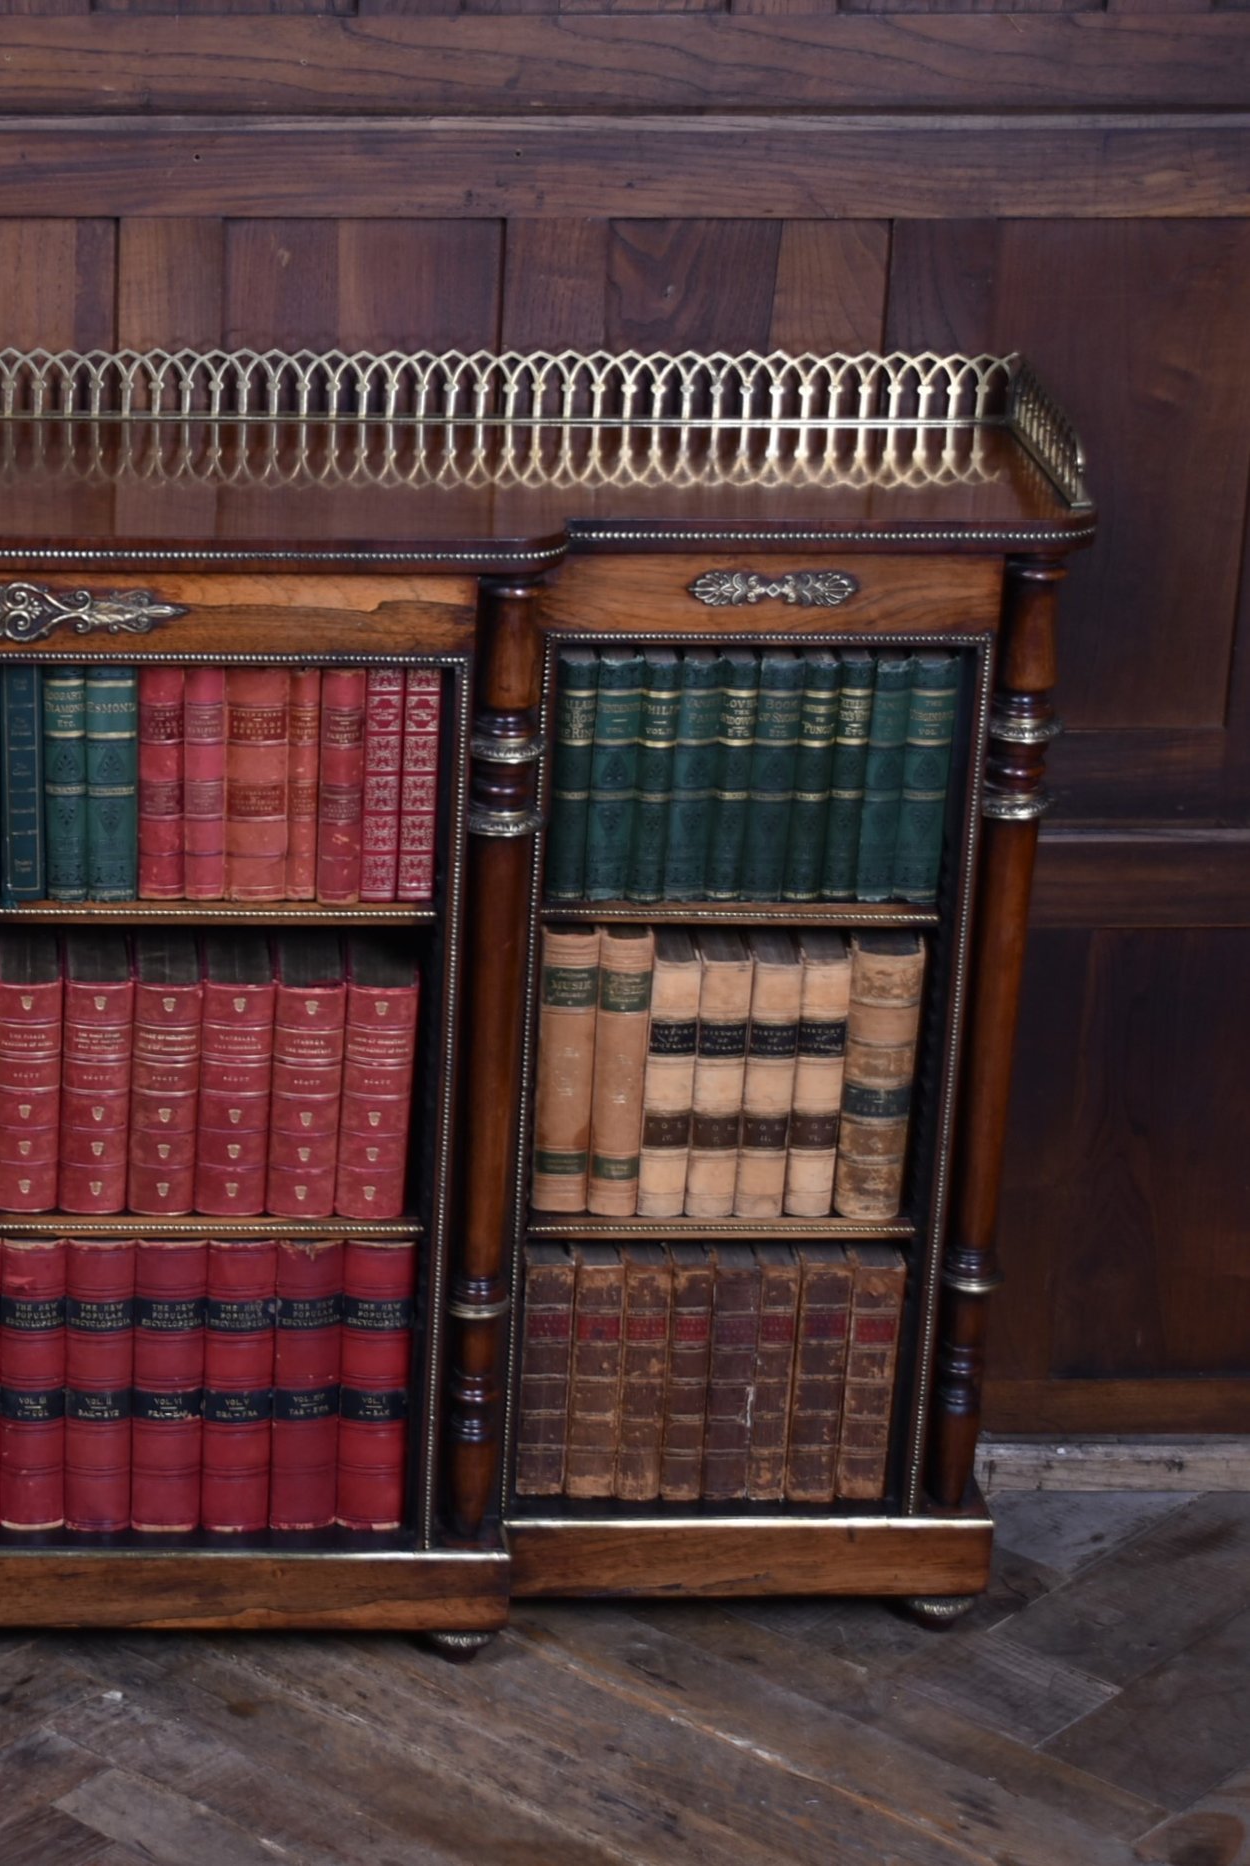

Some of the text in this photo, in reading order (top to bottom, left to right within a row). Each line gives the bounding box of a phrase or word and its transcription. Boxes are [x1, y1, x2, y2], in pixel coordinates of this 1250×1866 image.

[87, 701, 136, 714] ESMOND
[15, 1303, 32, 1311] THE
[221, 1304, 238, 1312] THE
[358, 1302, 375, 1311] THE
[16, 1311, 57, 1319] POPULAR
[81, 1311, 123, 1319] POPULAR
[152, 1311, 194, 1319] POPULAR
[220, 1312, 262, 1320] POPULAR
[293, 1308, 333, 1319] POPULAR
[358, 1311, 400, 1319] POPULAR
